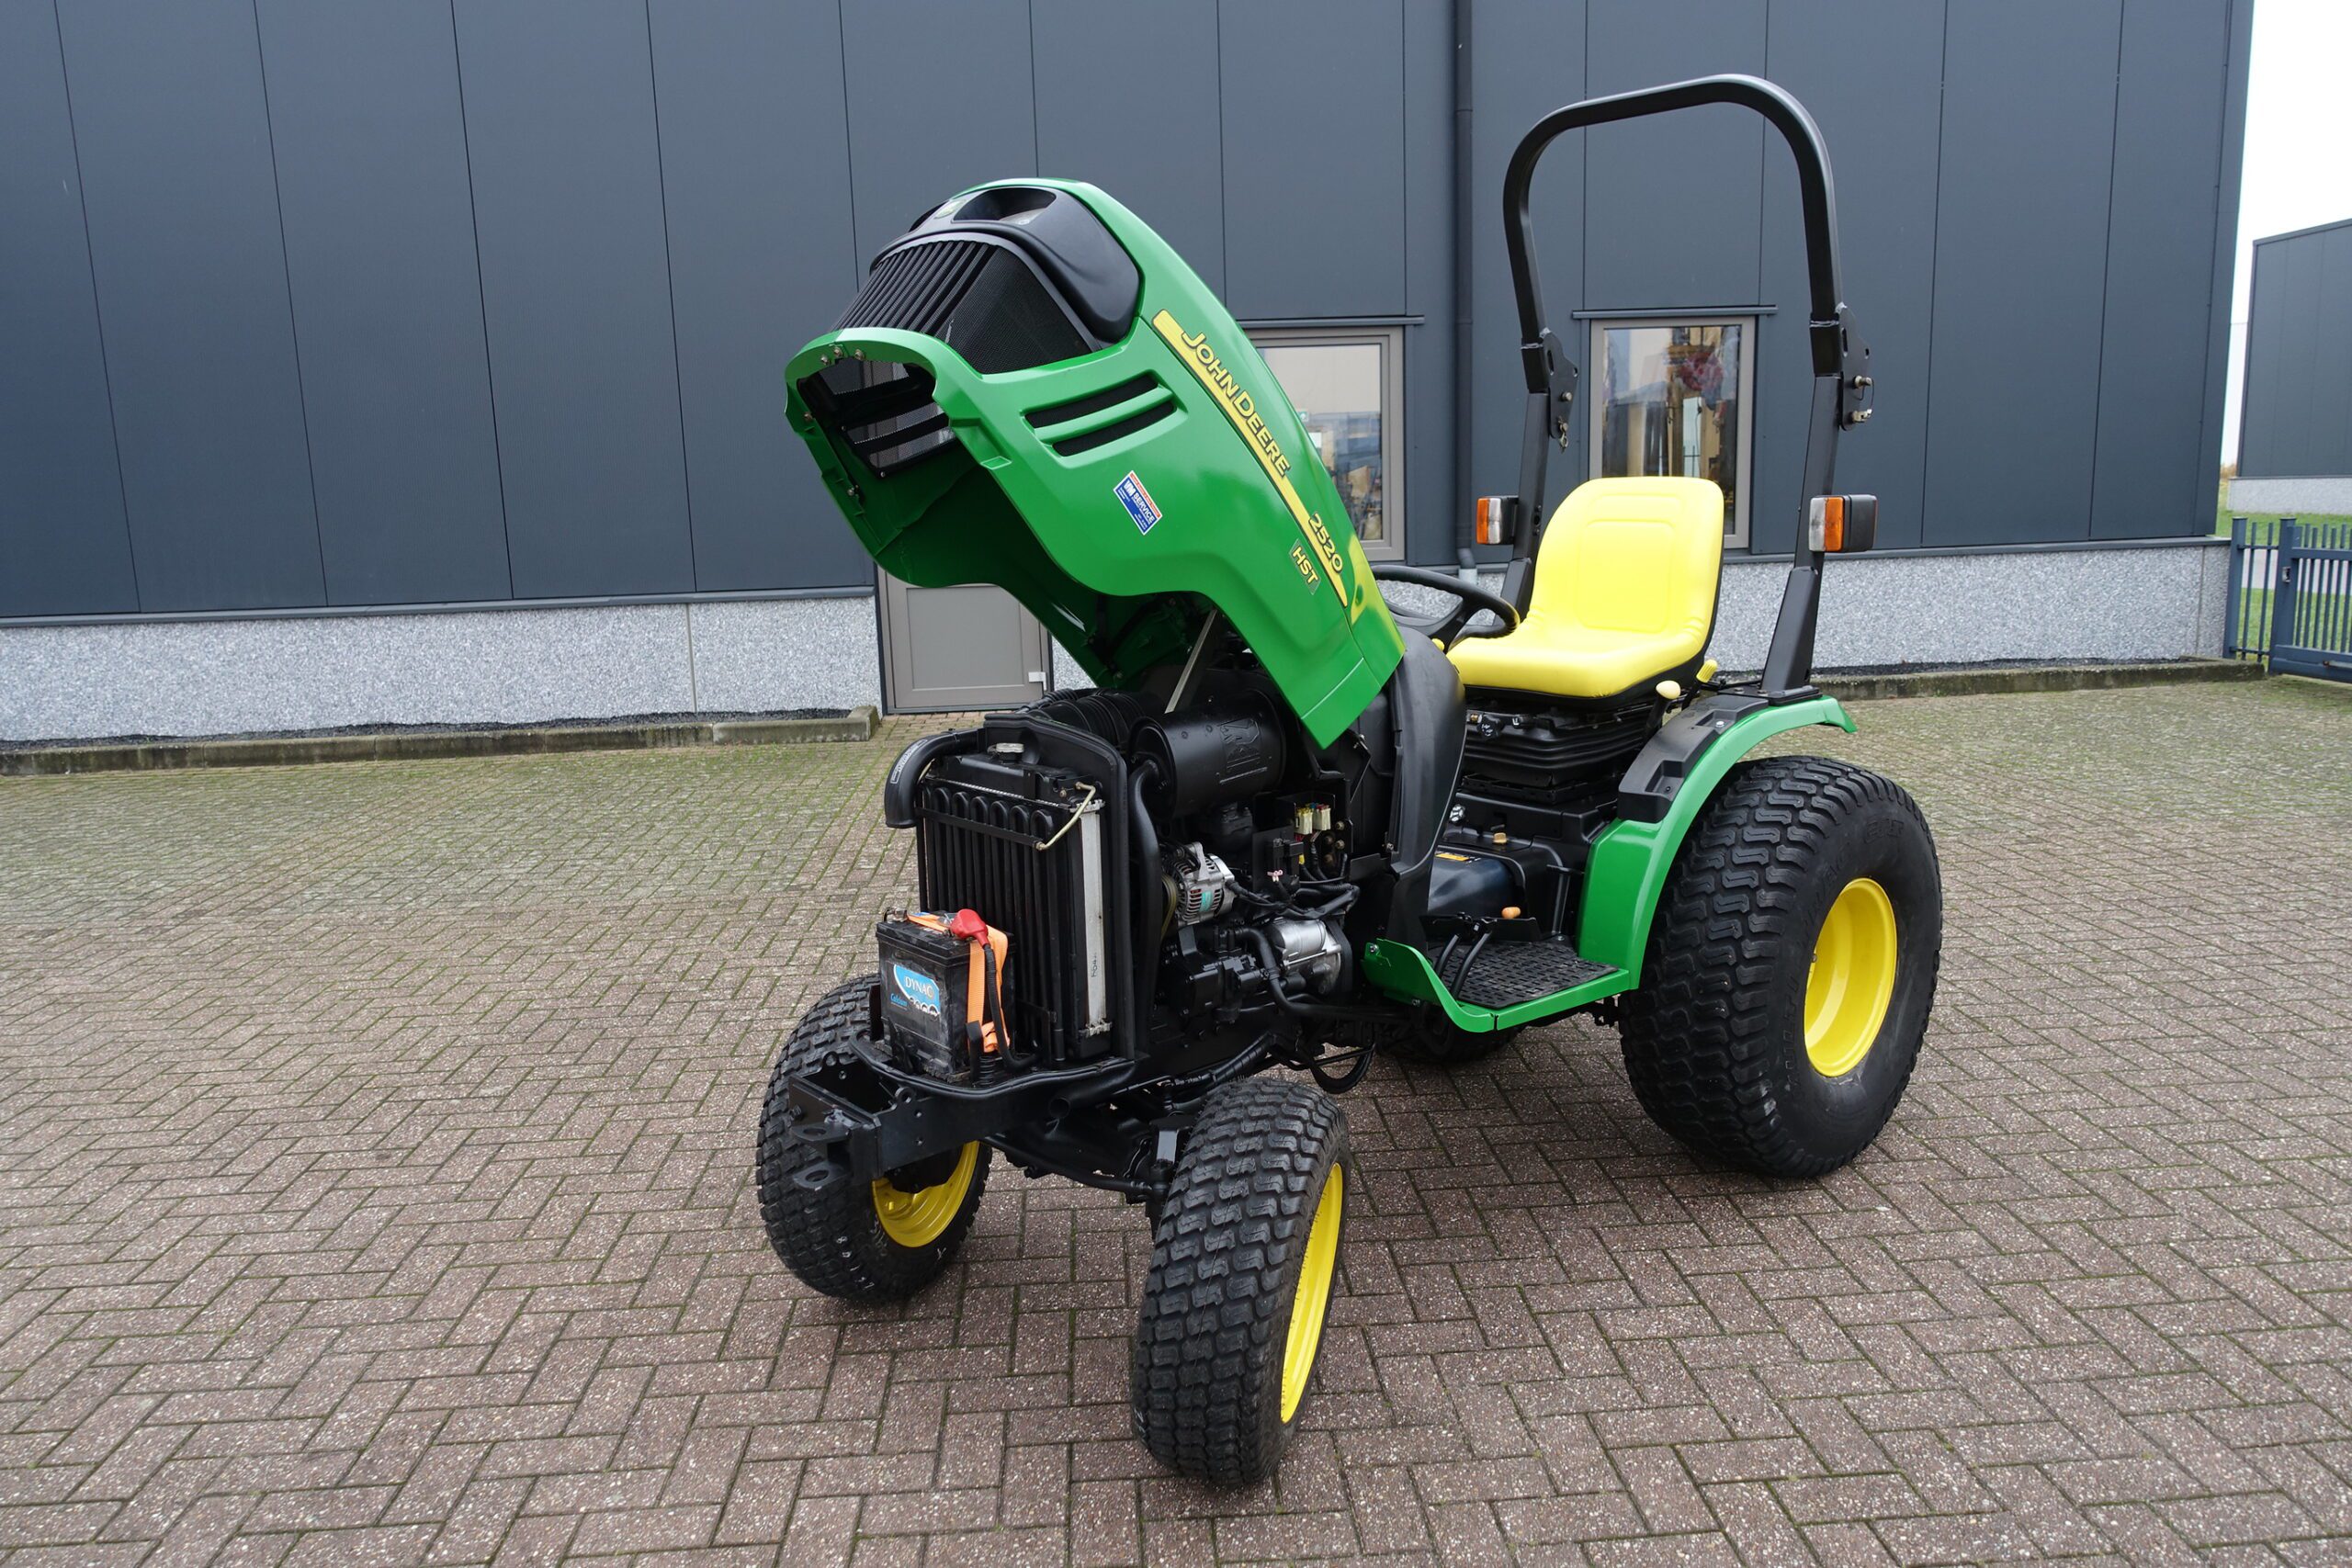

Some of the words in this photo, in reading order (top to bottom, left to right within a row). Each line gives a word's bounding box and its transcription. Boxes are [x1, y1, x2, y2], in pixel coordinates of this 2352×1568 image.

[1182, 331, 1239, 400] JOHN
[1233, 389, 1291, 477] DEERE
[1133, 491, 1155, 525] SERVICE
[1292, 545, 1318, 585] HST
[1308, 512, 1343, 573] 2520
